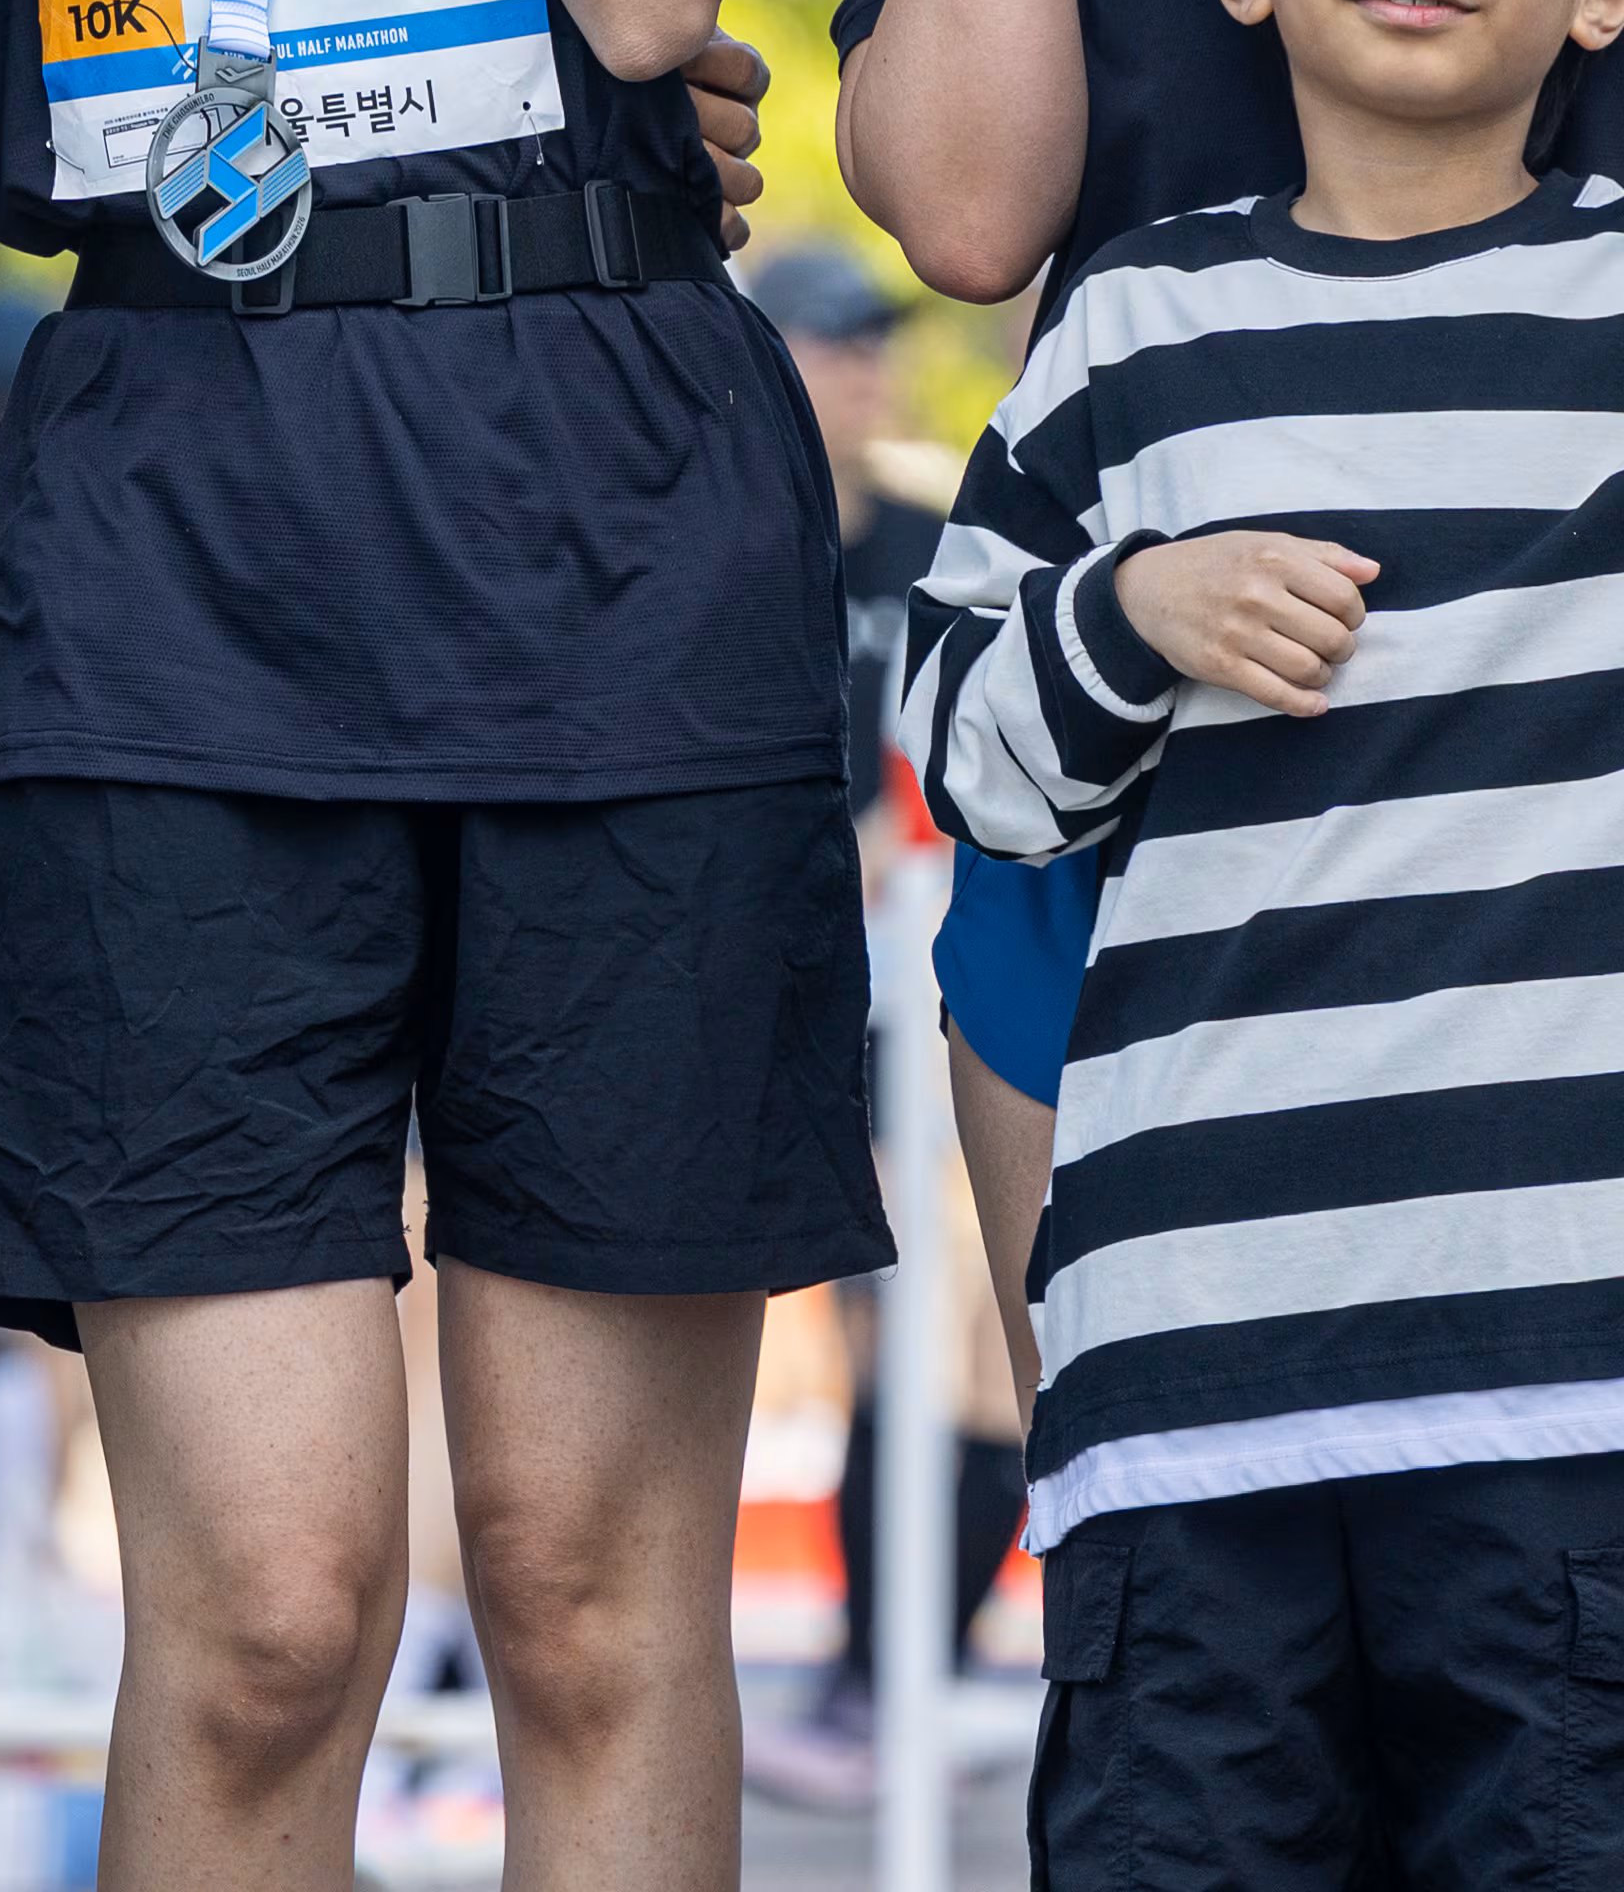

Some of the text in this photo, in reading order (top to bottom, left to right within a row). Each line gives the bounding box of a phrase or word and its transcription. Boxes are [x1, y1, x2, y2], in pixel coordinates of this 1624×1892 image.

[297, 37, 332, 57] HALF
[335, 26, 409, 52] MARATHON
[162, 122, 175, 139] THE
[237, 216, 306, 277] SEOUL HALF MARATHON 2026
